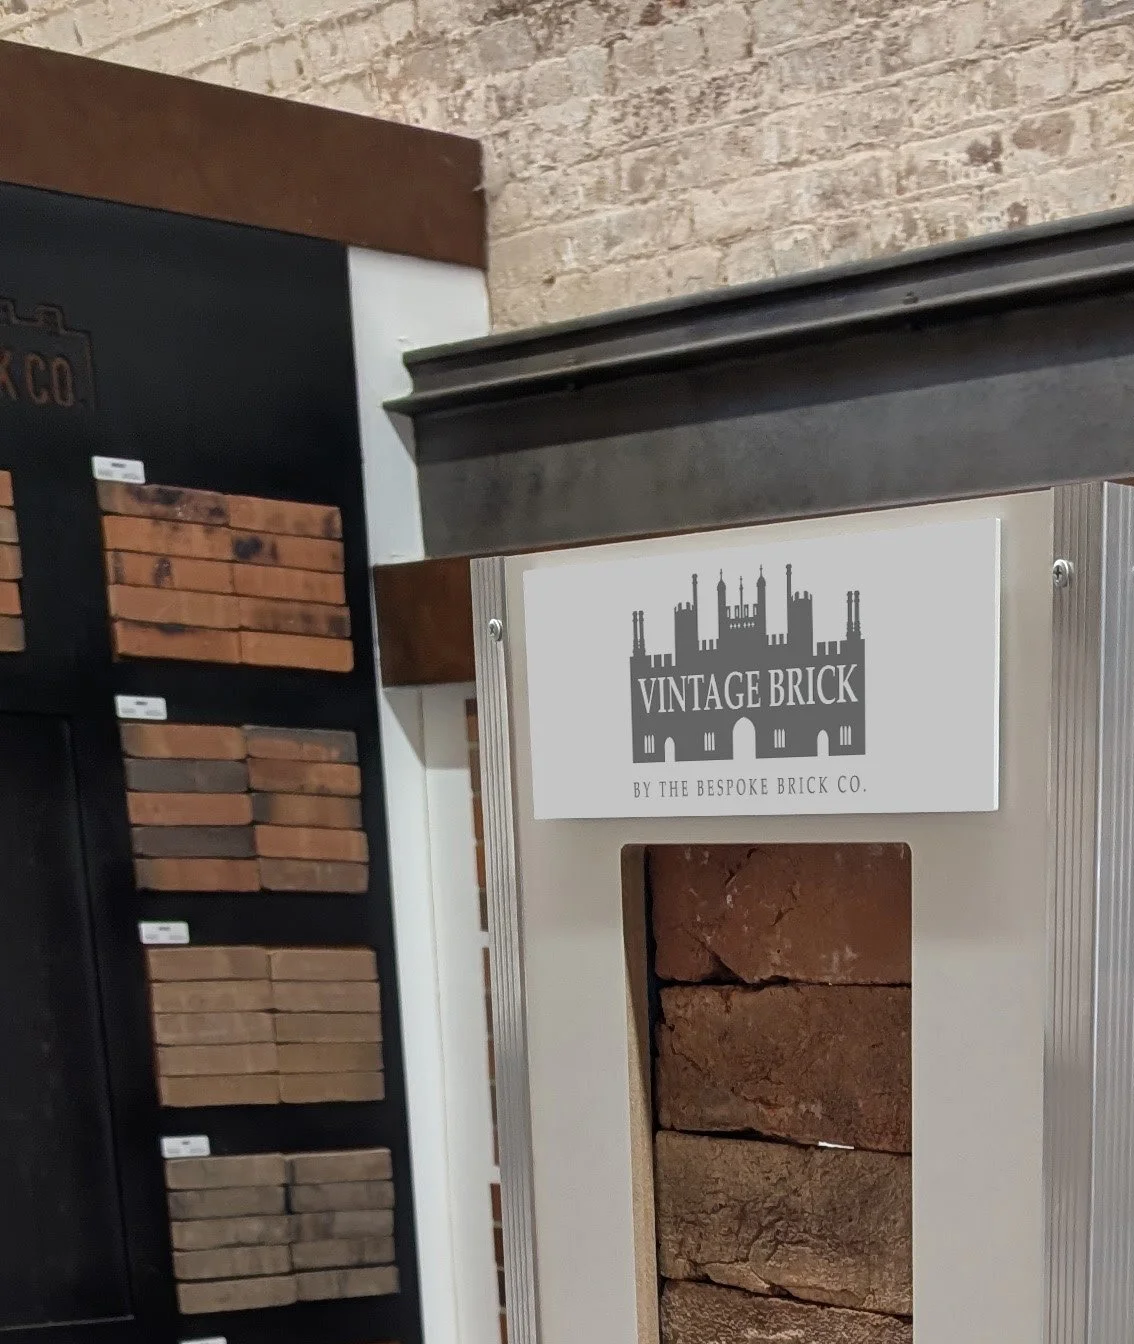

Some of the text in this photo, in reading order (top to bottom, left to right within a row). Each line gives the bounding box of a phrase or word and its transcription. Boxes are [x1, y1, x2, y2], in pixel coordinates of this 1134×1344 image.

[638, 664, 858, 713] VINTAGE BRICK
[633, 775, 866, 798] BY THE BESPOKE BRICK CO.
